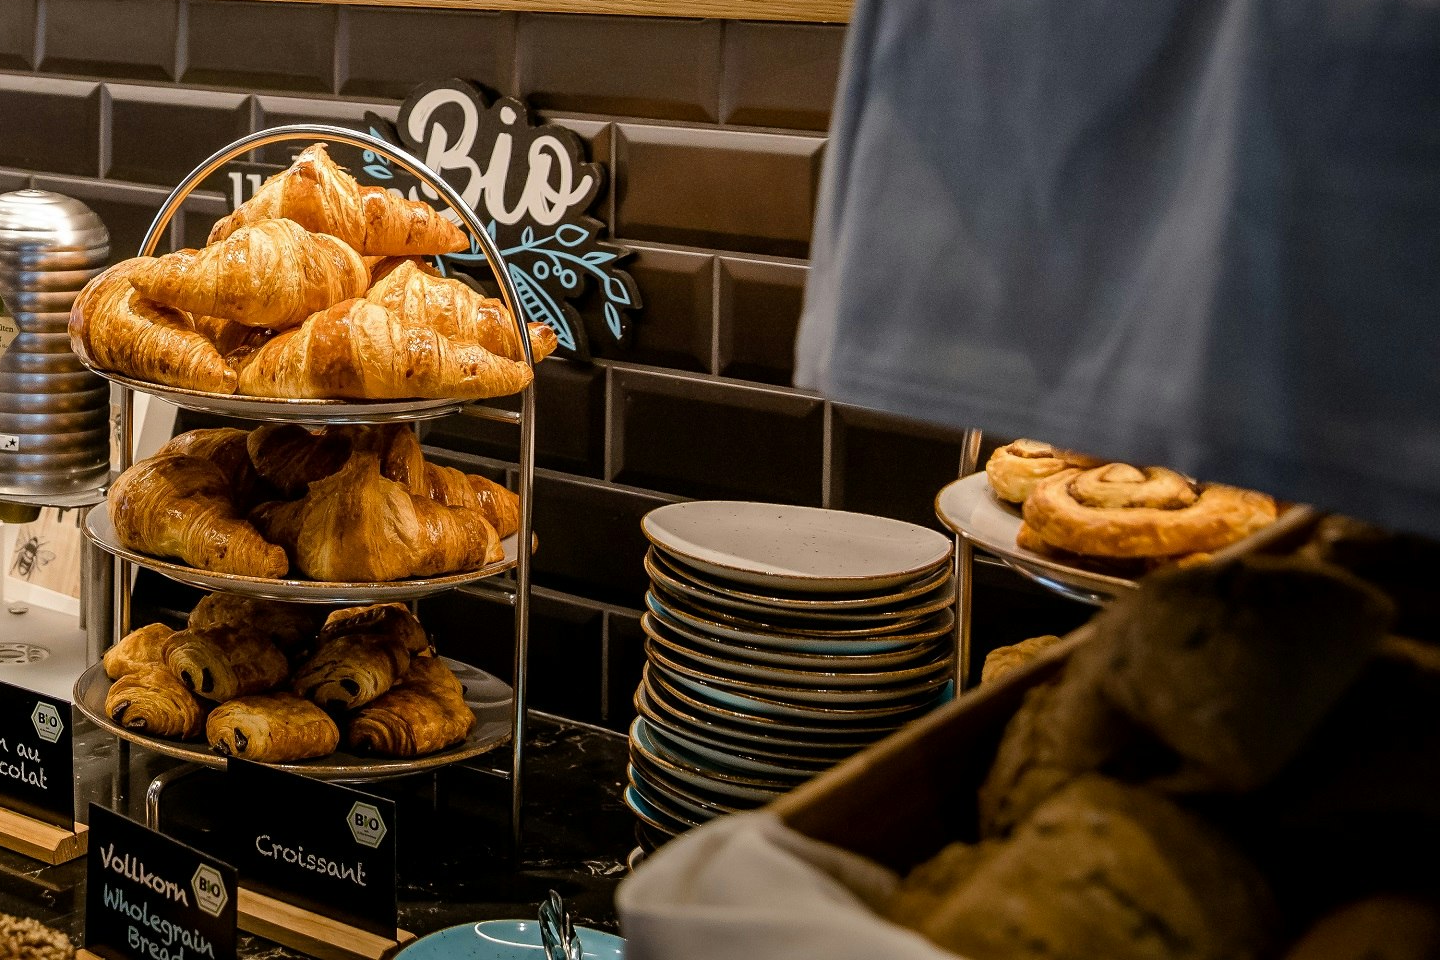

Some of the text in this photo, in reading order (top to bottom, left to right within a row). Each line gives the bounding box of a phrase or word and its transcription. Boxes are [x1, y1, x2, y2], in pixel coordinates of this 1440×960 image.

[406, 88, 594, 227] Bio
[16, 743, 41, 763] au
[100, 843, 189, 907] Vollkorn
[255, 834, 367, 887] Croissant
[103, 883, 215, 960] Wholegrain
